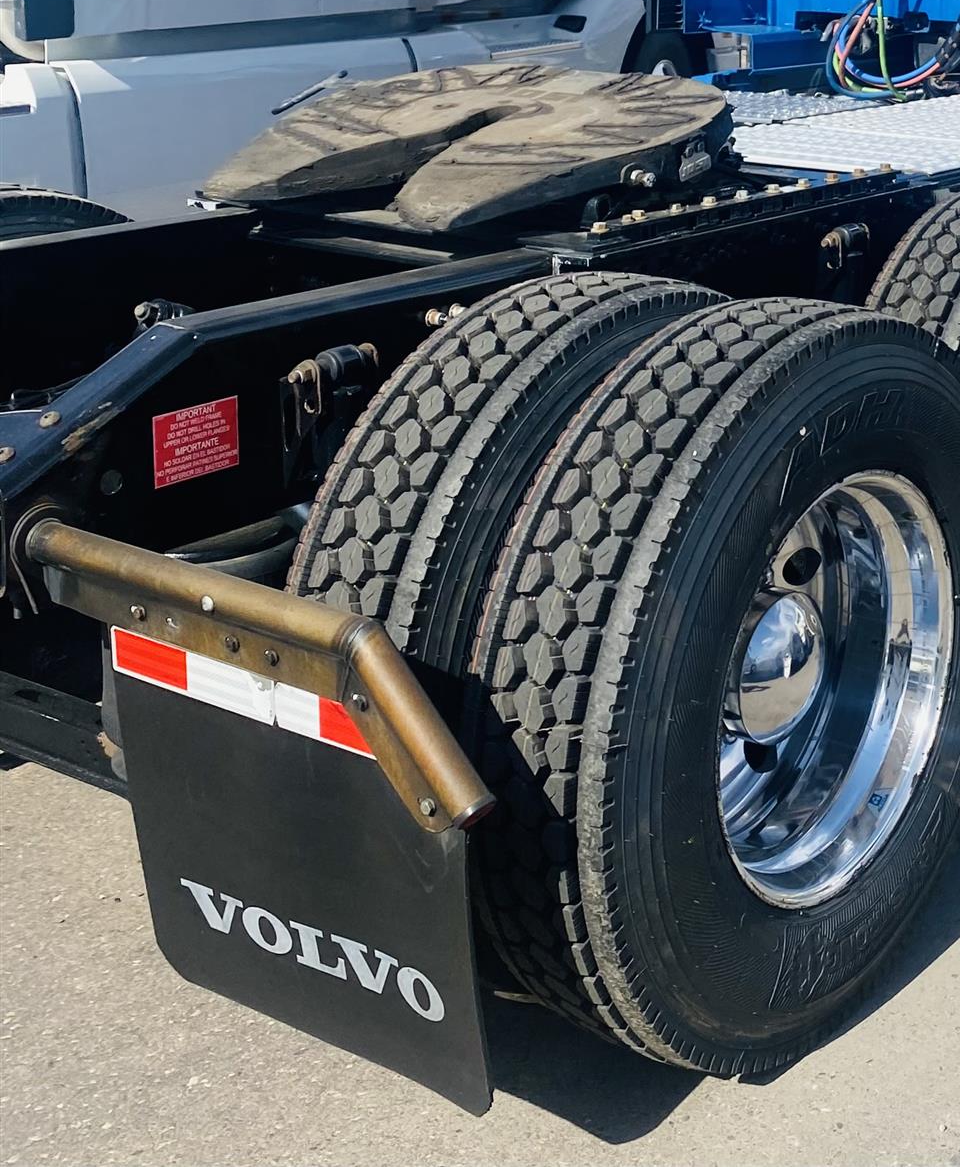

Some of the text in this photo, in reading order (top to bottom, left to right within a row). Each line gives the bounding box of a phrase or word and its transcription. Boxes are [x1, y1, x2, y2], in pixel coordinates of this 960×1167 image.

[176, 404, 216, 421] IMPORTANT
[170, 423, 178, 431] DO
[179, 420, 189, 428] NOT
[167, 432, 175, 440] DO
[176, 429, 186, 437] NOT
[175, 437, 219, 456] IMPORTANTE
[180, 878, 445, 1022] VOLVO
